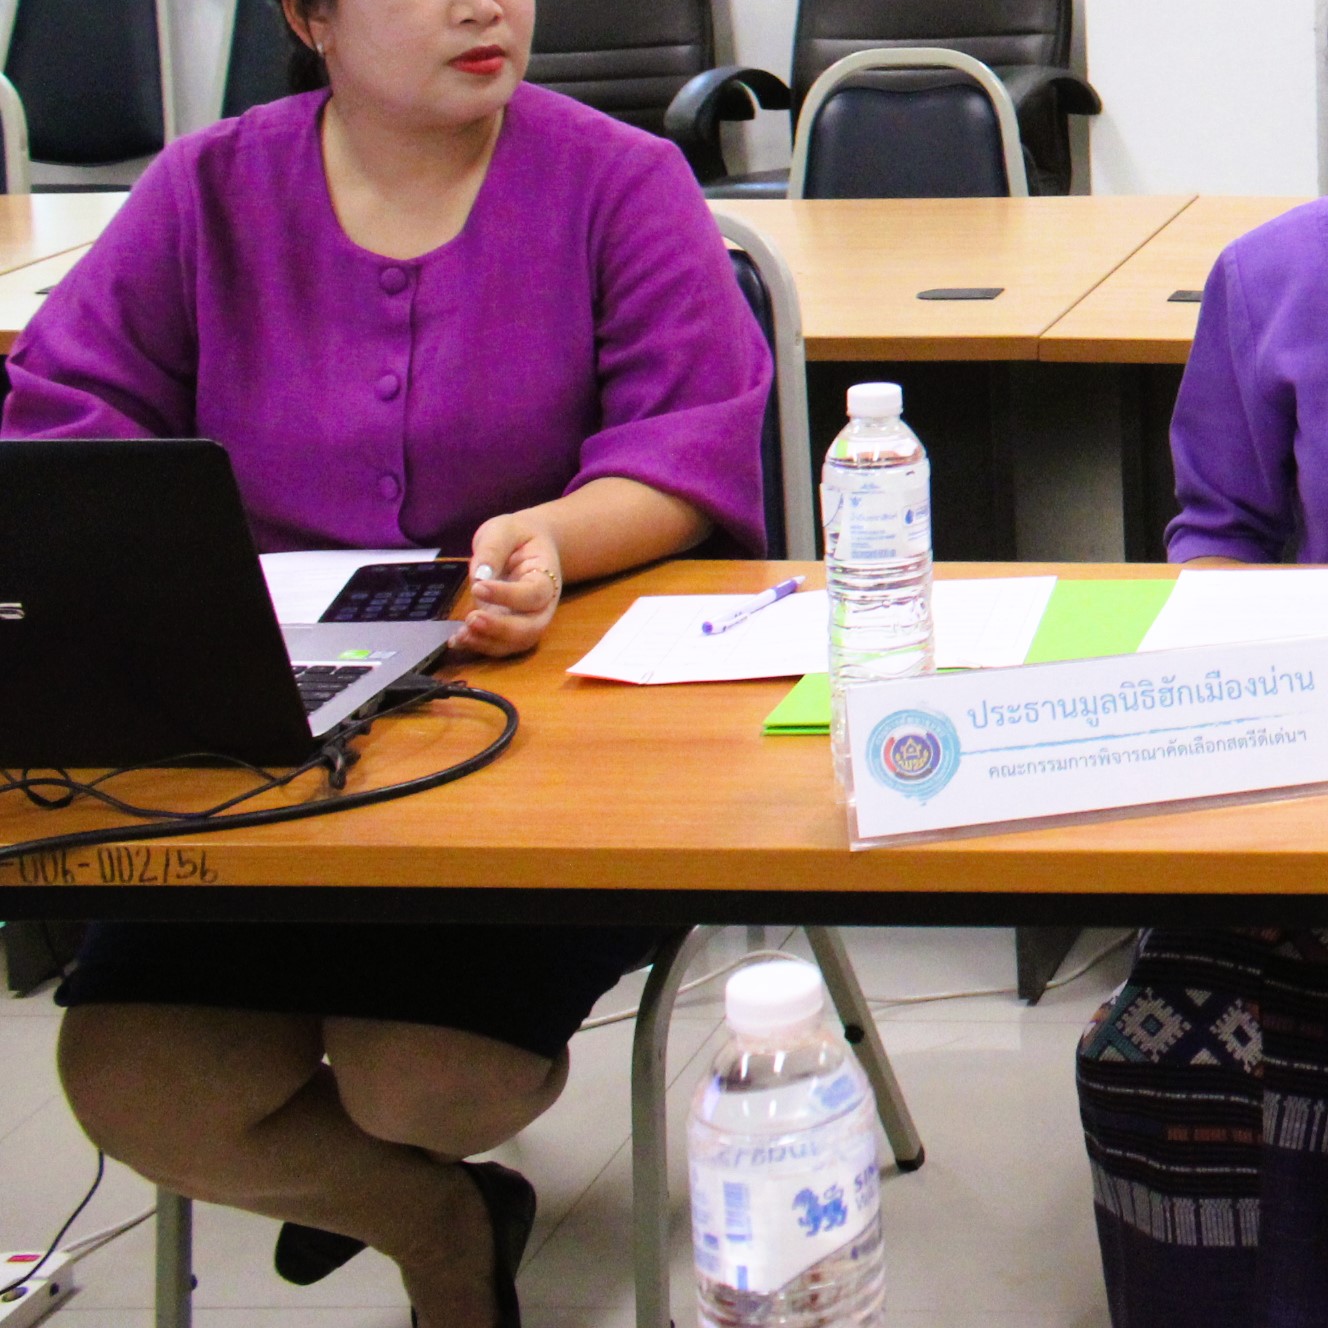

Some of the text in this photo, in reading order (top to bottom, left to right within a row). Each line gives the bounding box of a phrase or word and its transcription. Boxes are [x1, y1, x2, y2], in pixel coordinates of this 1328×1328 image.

[967, 664, 1315, 729] ประธานมูลนิธิฮักเมืองน่าน
[987, 729, 1307, 779] คณะกรรมการพิจารณาคัดเลือกสตรีดีเด่นฯ
